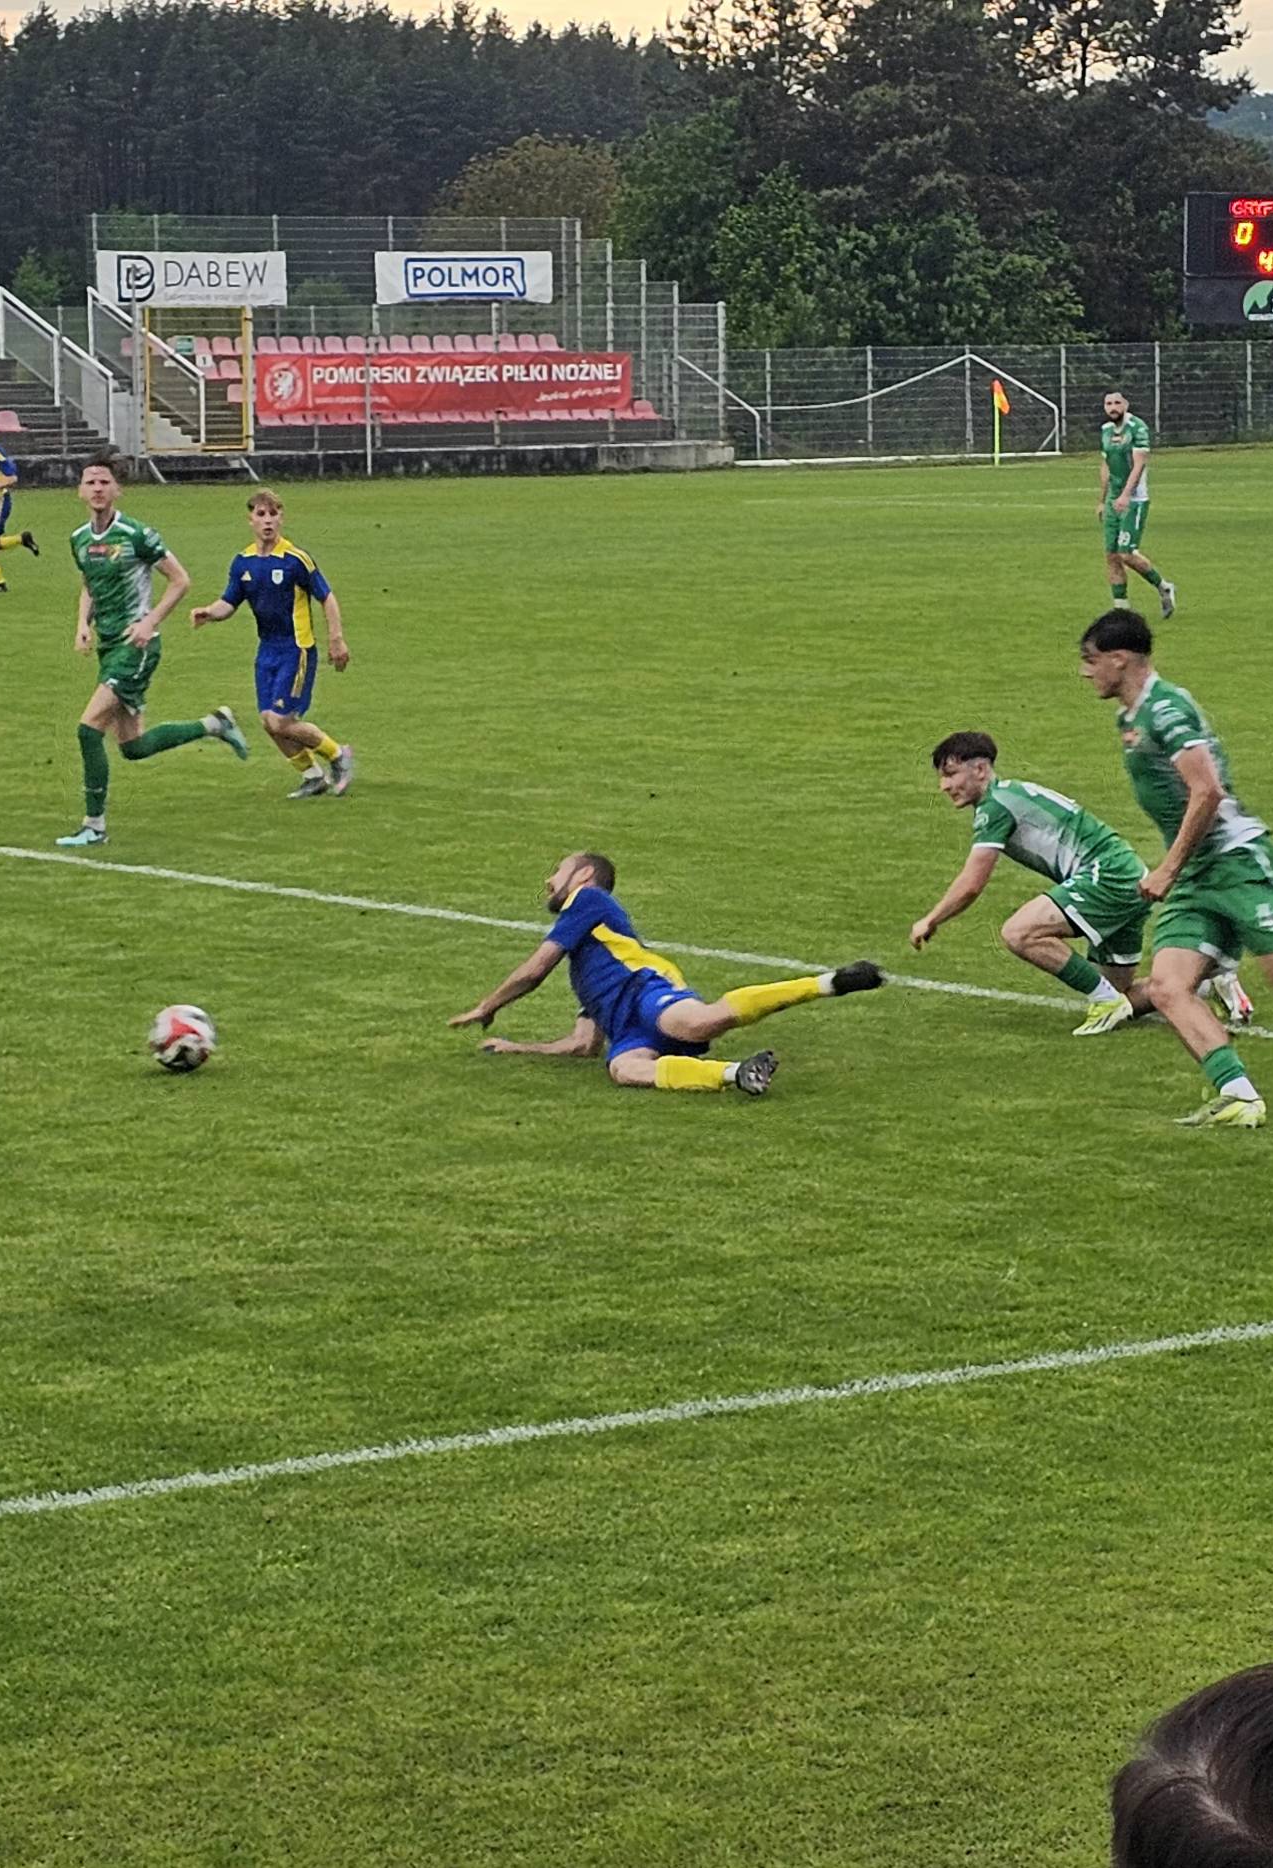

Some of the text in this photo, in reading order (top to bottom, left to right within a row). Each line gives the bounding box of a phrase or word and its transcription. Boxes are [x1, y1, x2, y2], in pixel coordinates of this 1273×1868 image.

[1235, 221, 1254, 245] 0
[164, 259, 268, 287] DABEW
[413, 266, 516, 288] POLMOR
[312, 360, 622, 386] POMORSKI ZWIĄZEK PIŁKI NOŻNEJ
